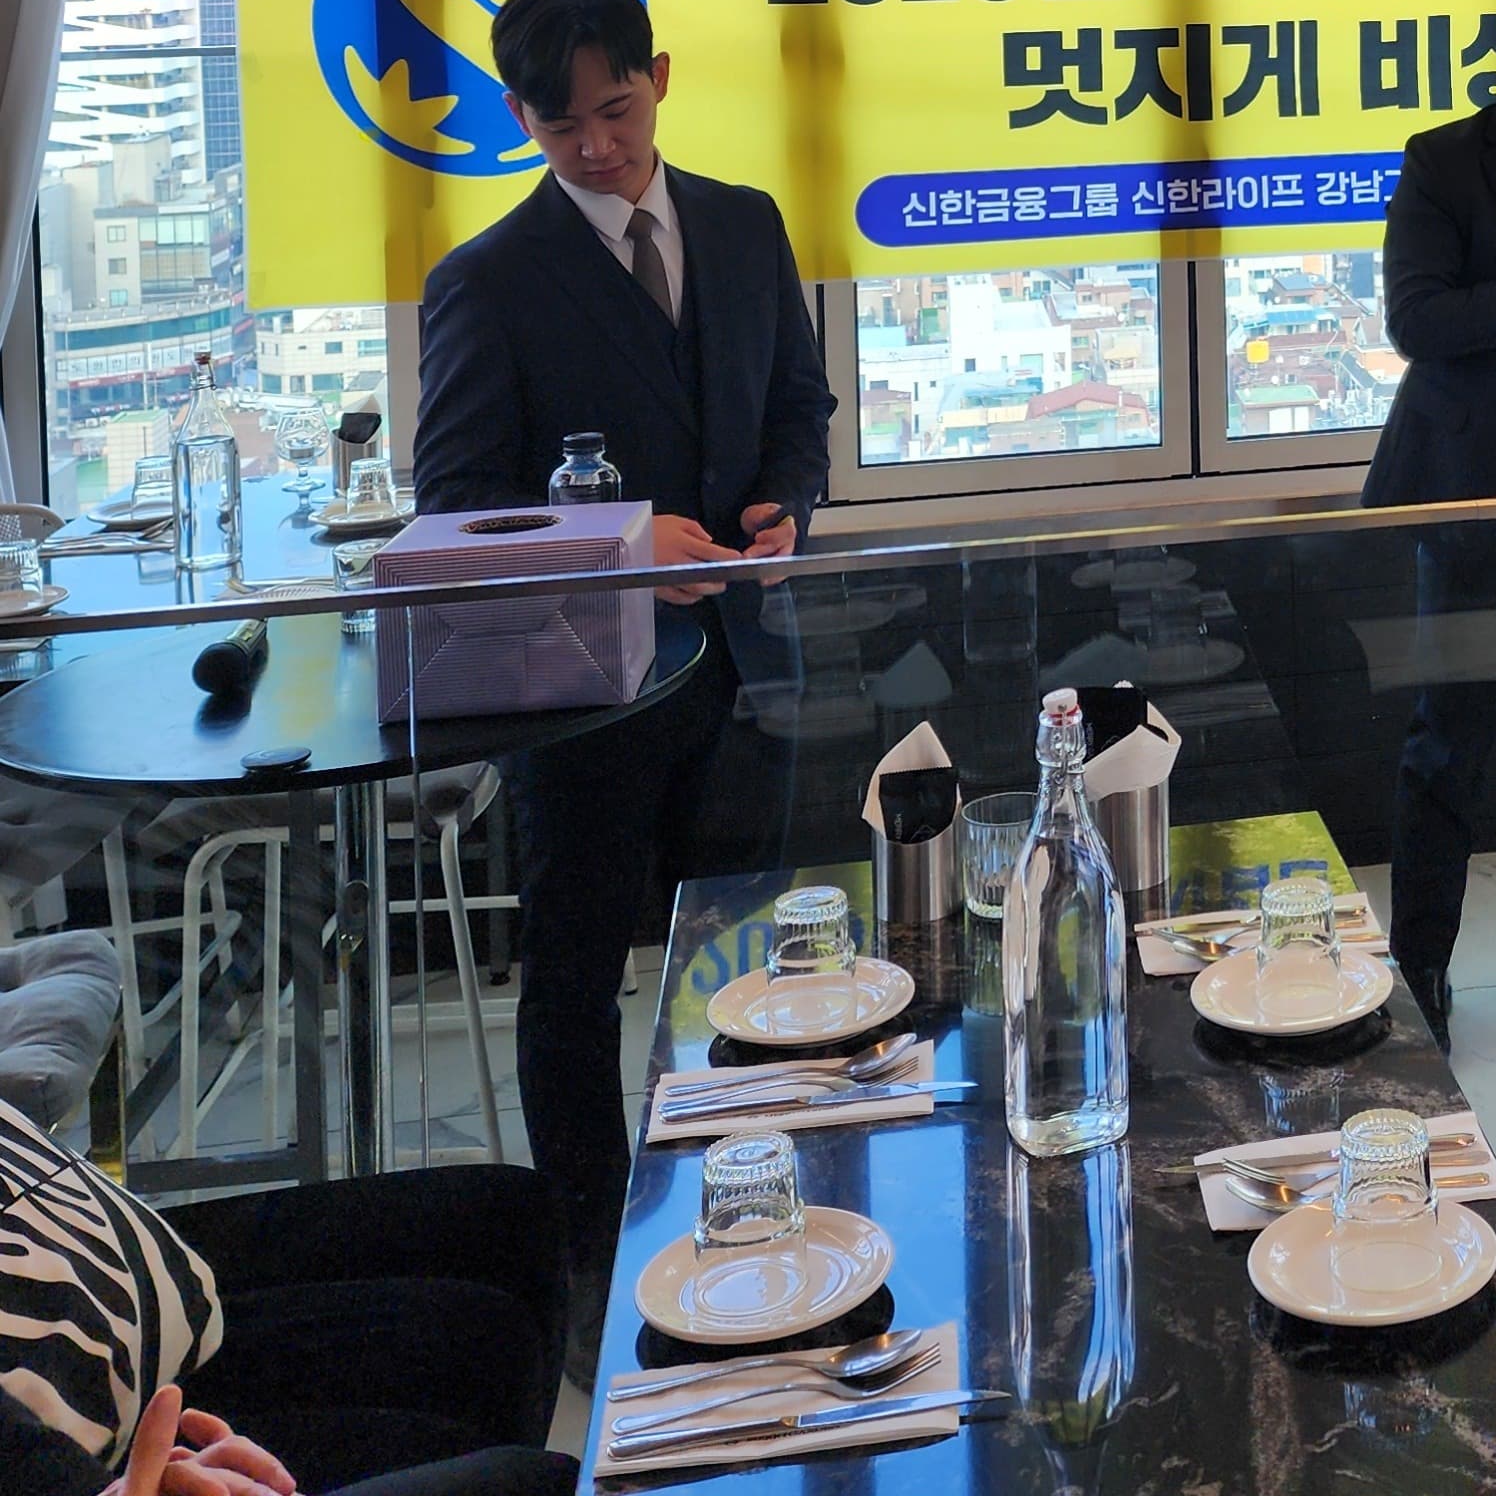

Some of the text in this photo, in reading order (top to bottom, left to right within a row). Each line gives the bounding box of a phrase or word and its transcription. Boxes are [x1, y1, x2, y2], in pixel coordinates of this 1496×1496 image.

[1003, 19, 1320, 129] 멋지게
[902, 182, 1119, 227] 신한금융그룹
[1132, 174, 1304, 215] 신한라이프
